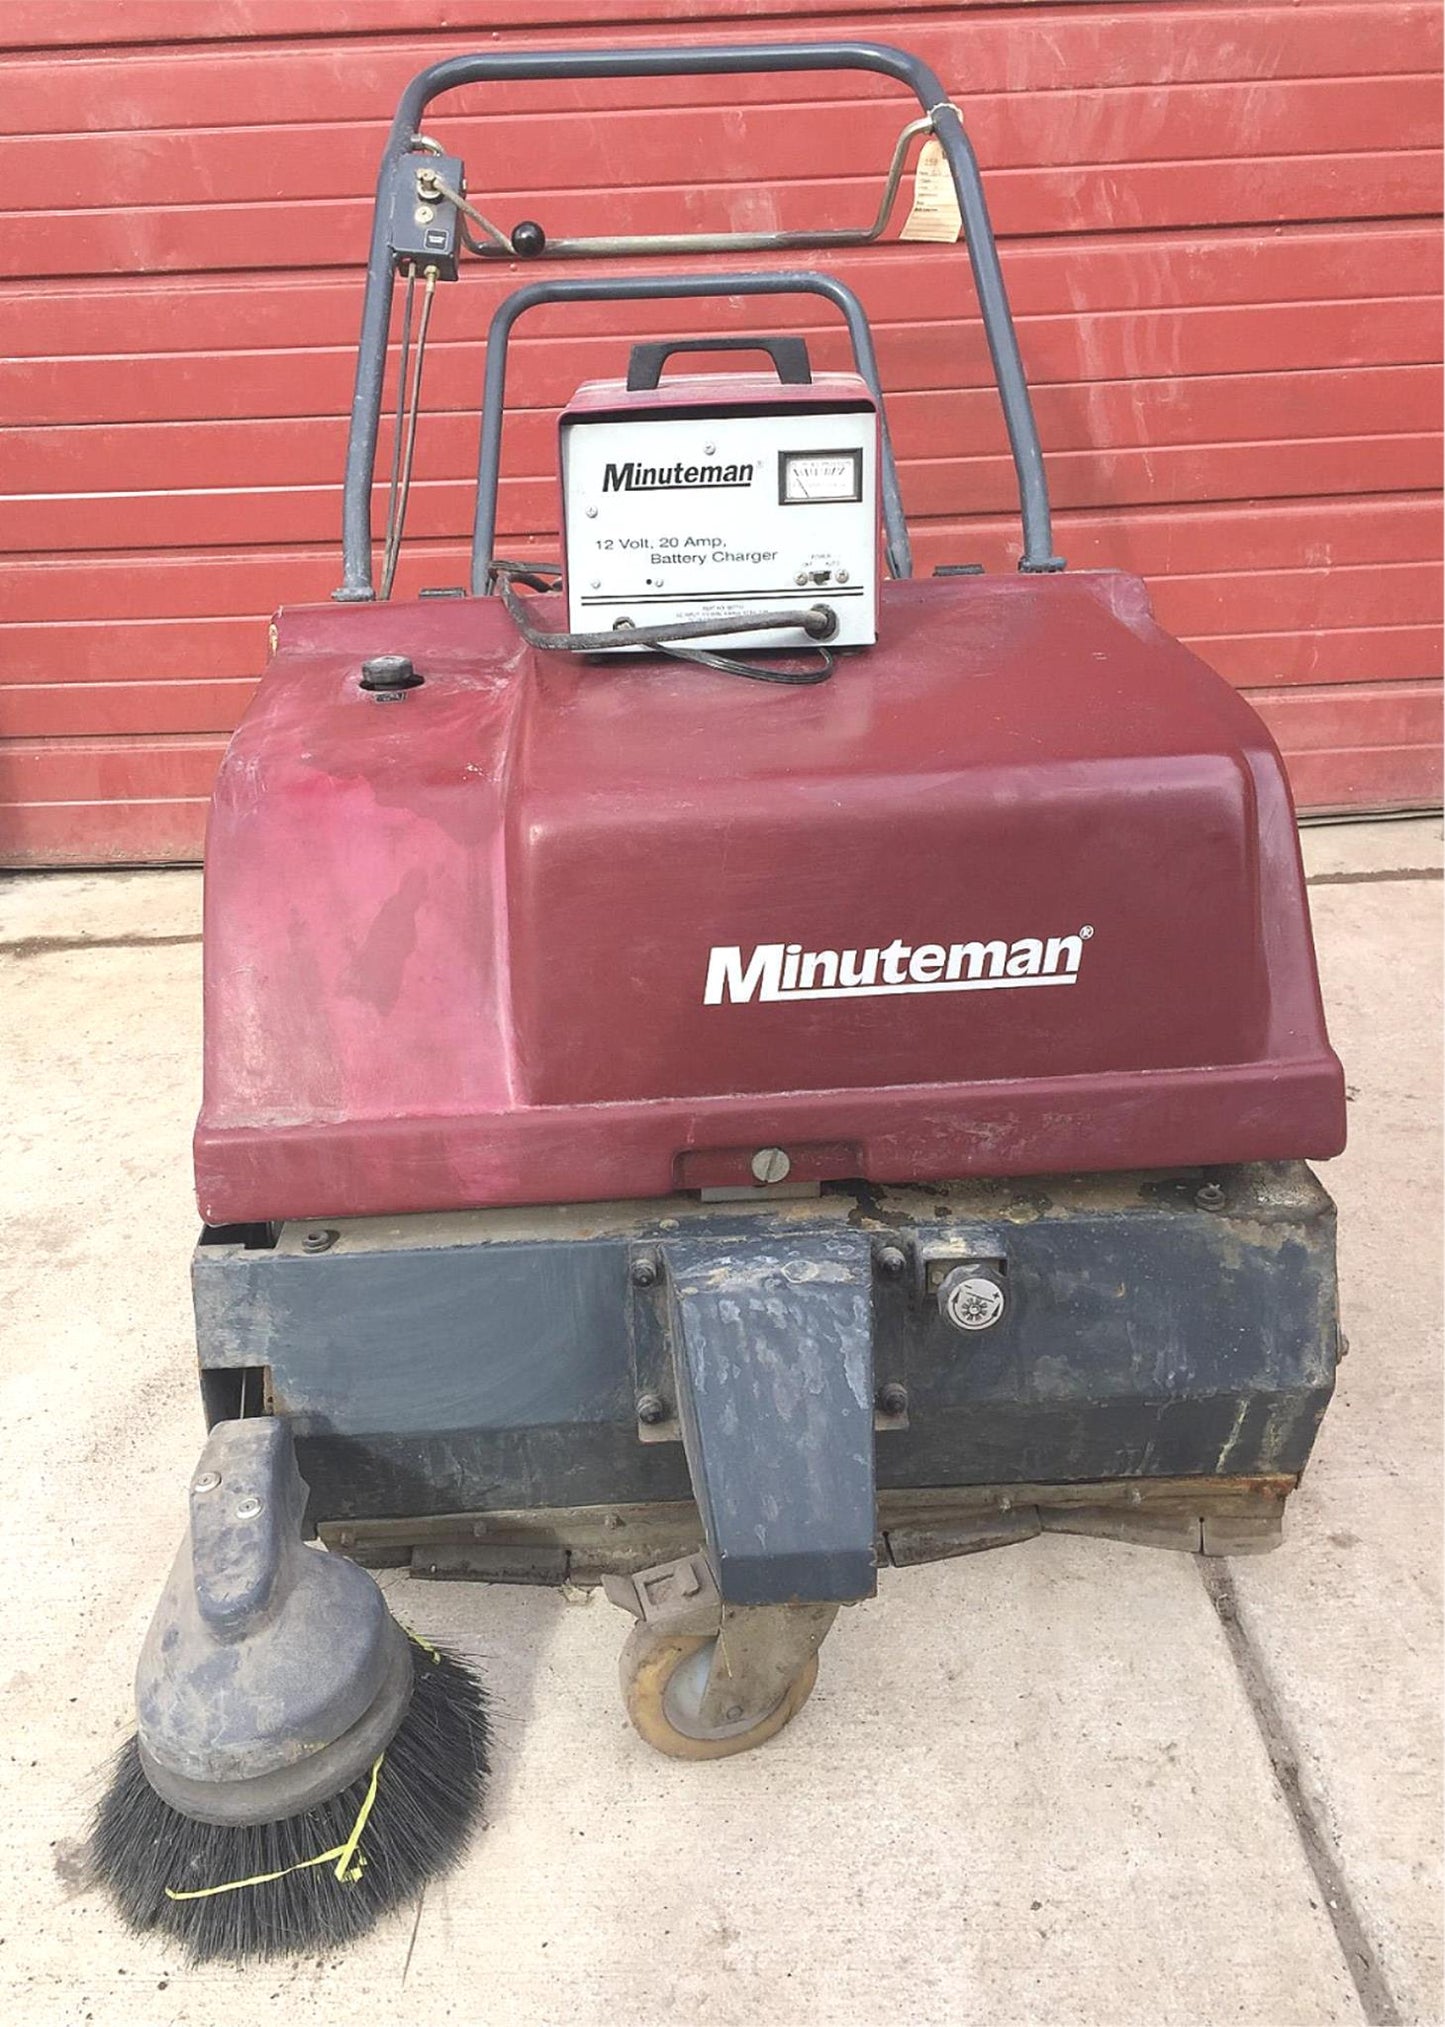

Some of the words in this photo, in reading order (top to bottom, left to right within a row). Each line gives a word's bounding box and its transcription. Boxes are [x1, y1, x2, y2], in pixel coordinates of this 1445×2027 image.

[602, 462, 754, 492] Minuteman
[596, 539, 614, 550] 12
[659, 537, 679, 549] 20
[684, 535, 727, 549] Amp,
[651, 552, 707, 566] Battery
[712, 550, 777, 564] Charger
